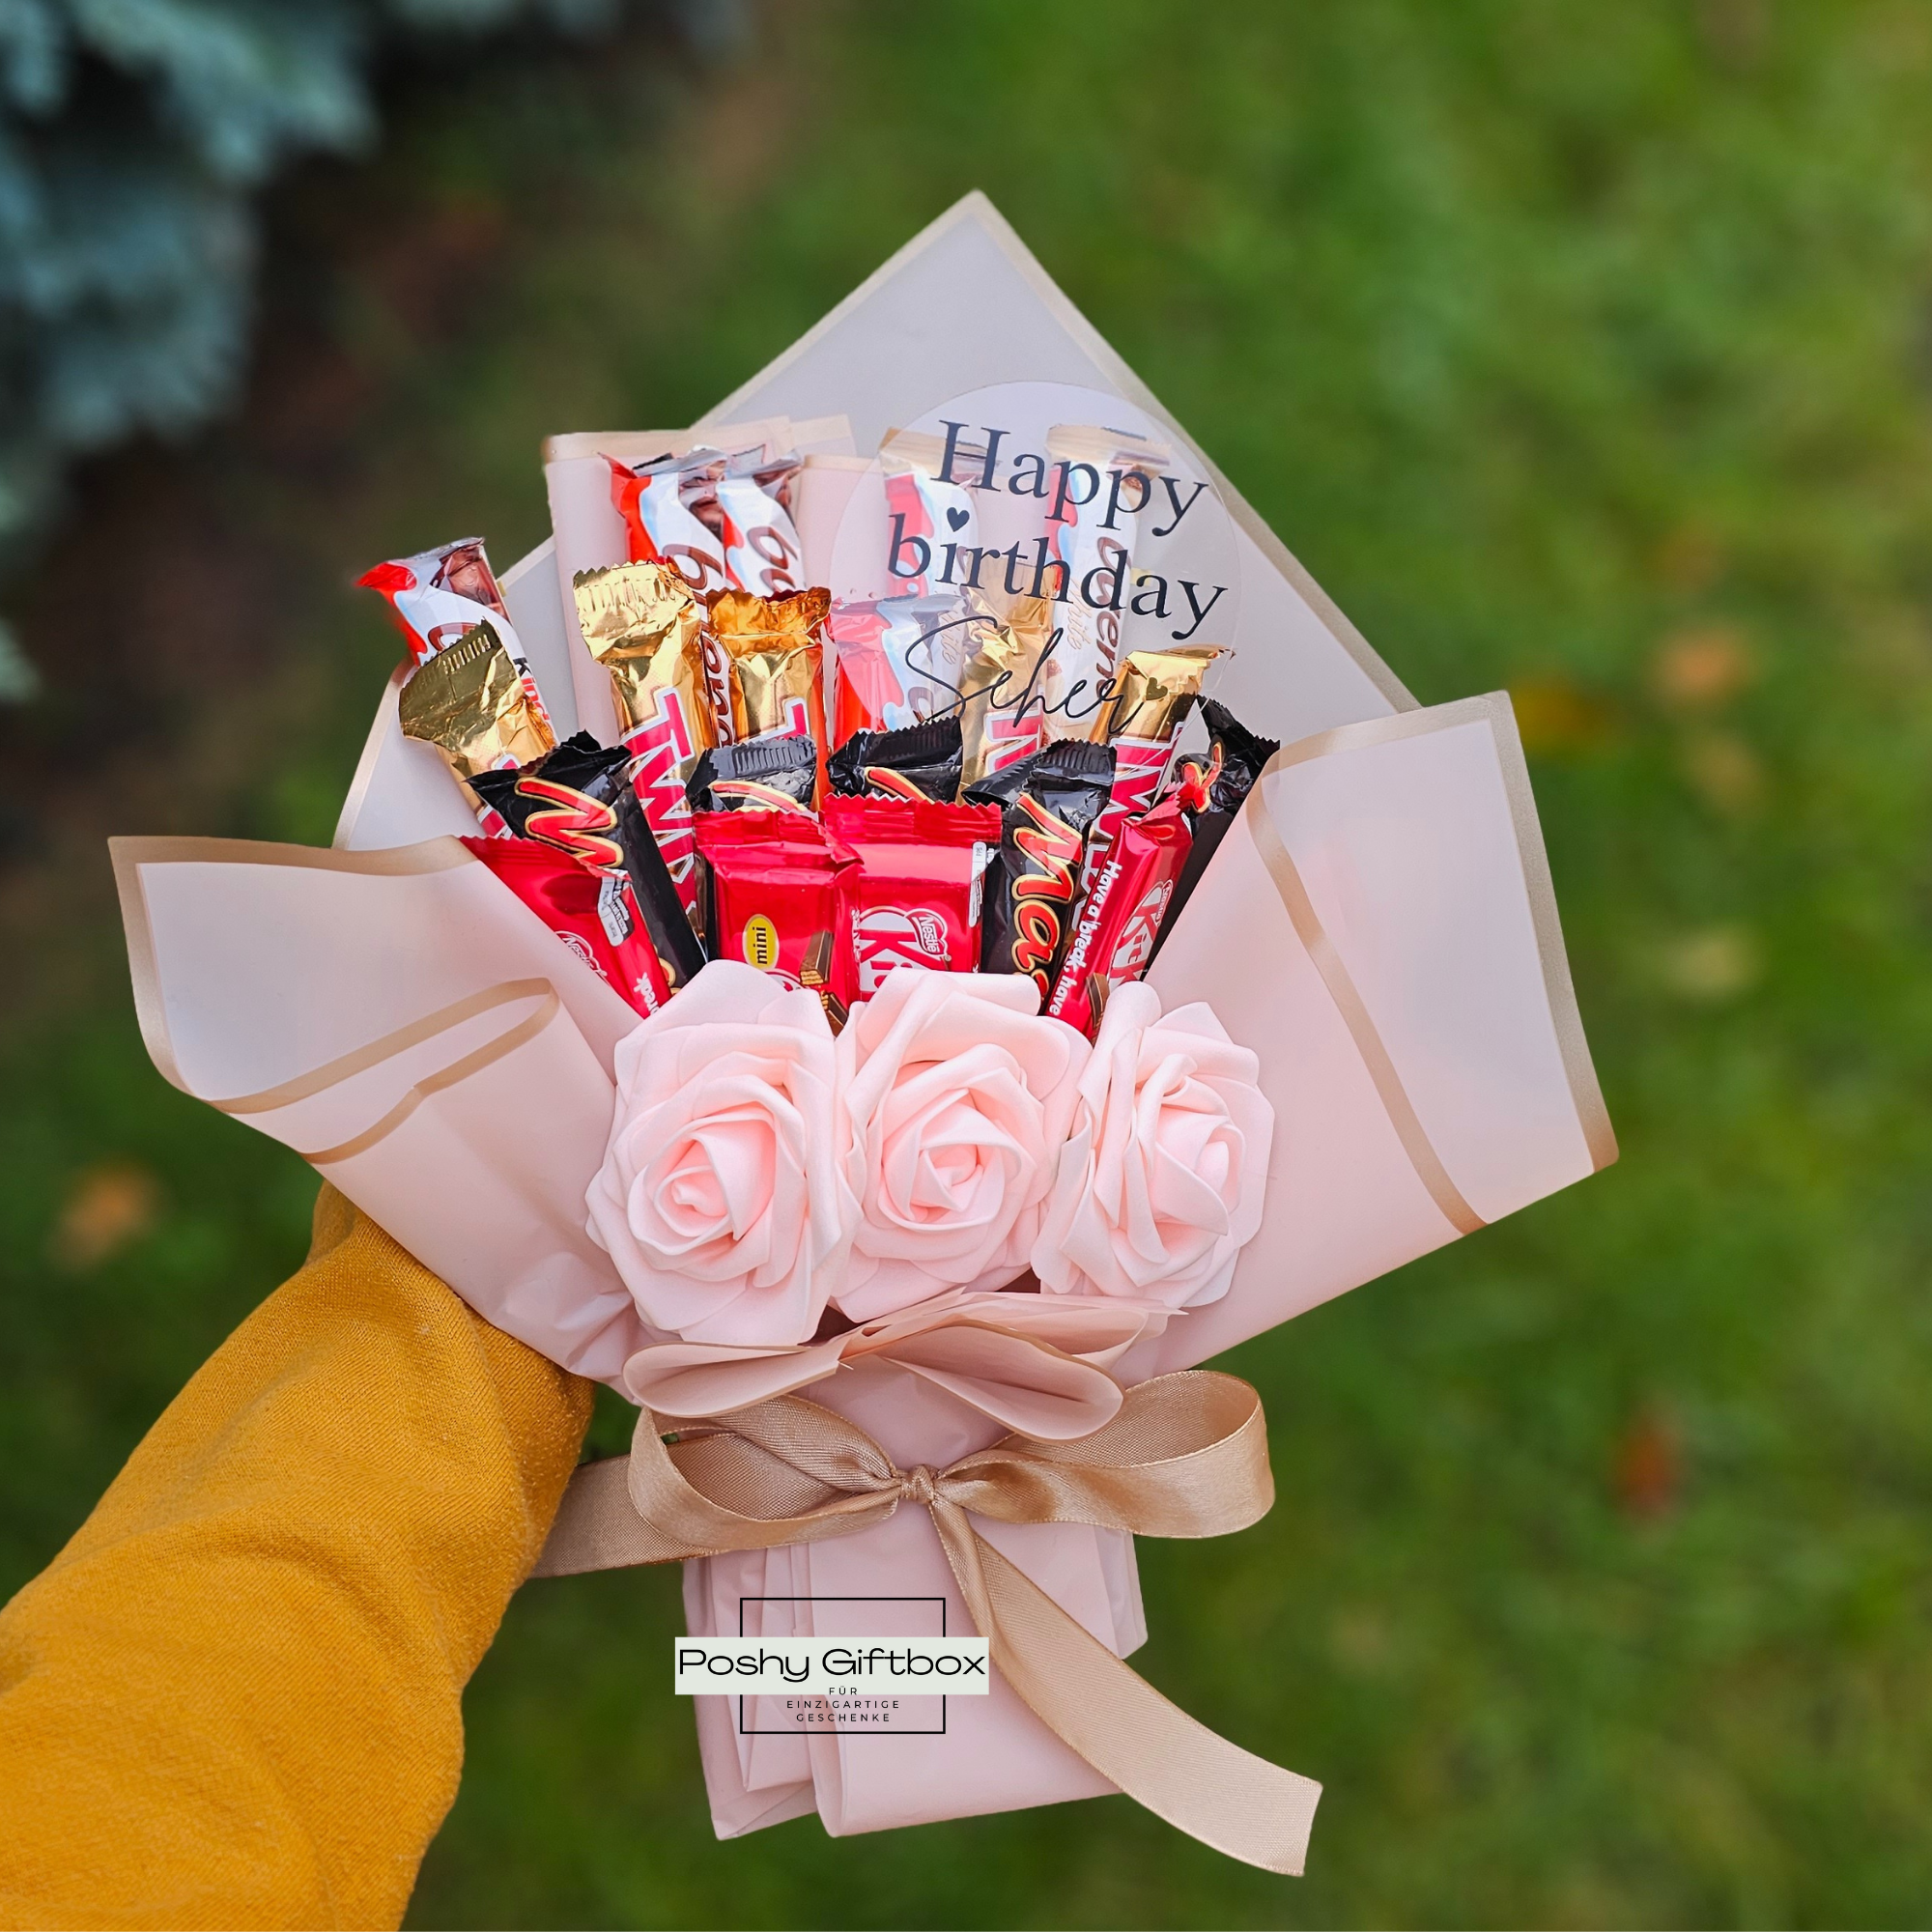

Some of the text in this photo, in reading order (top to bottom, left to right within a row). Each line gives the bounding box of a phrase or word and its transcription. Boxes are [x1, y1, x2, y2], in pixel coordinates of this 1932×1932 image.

[931, 419, 1208, 536] Happy
[887, 507, 1228, 639] birthday
[1093, 859, 1122, 903] Have
[1086, 906, 1097, 919] a
[752, 925, 769, 965] mini
[1048, 974, 1078, 1017] have
